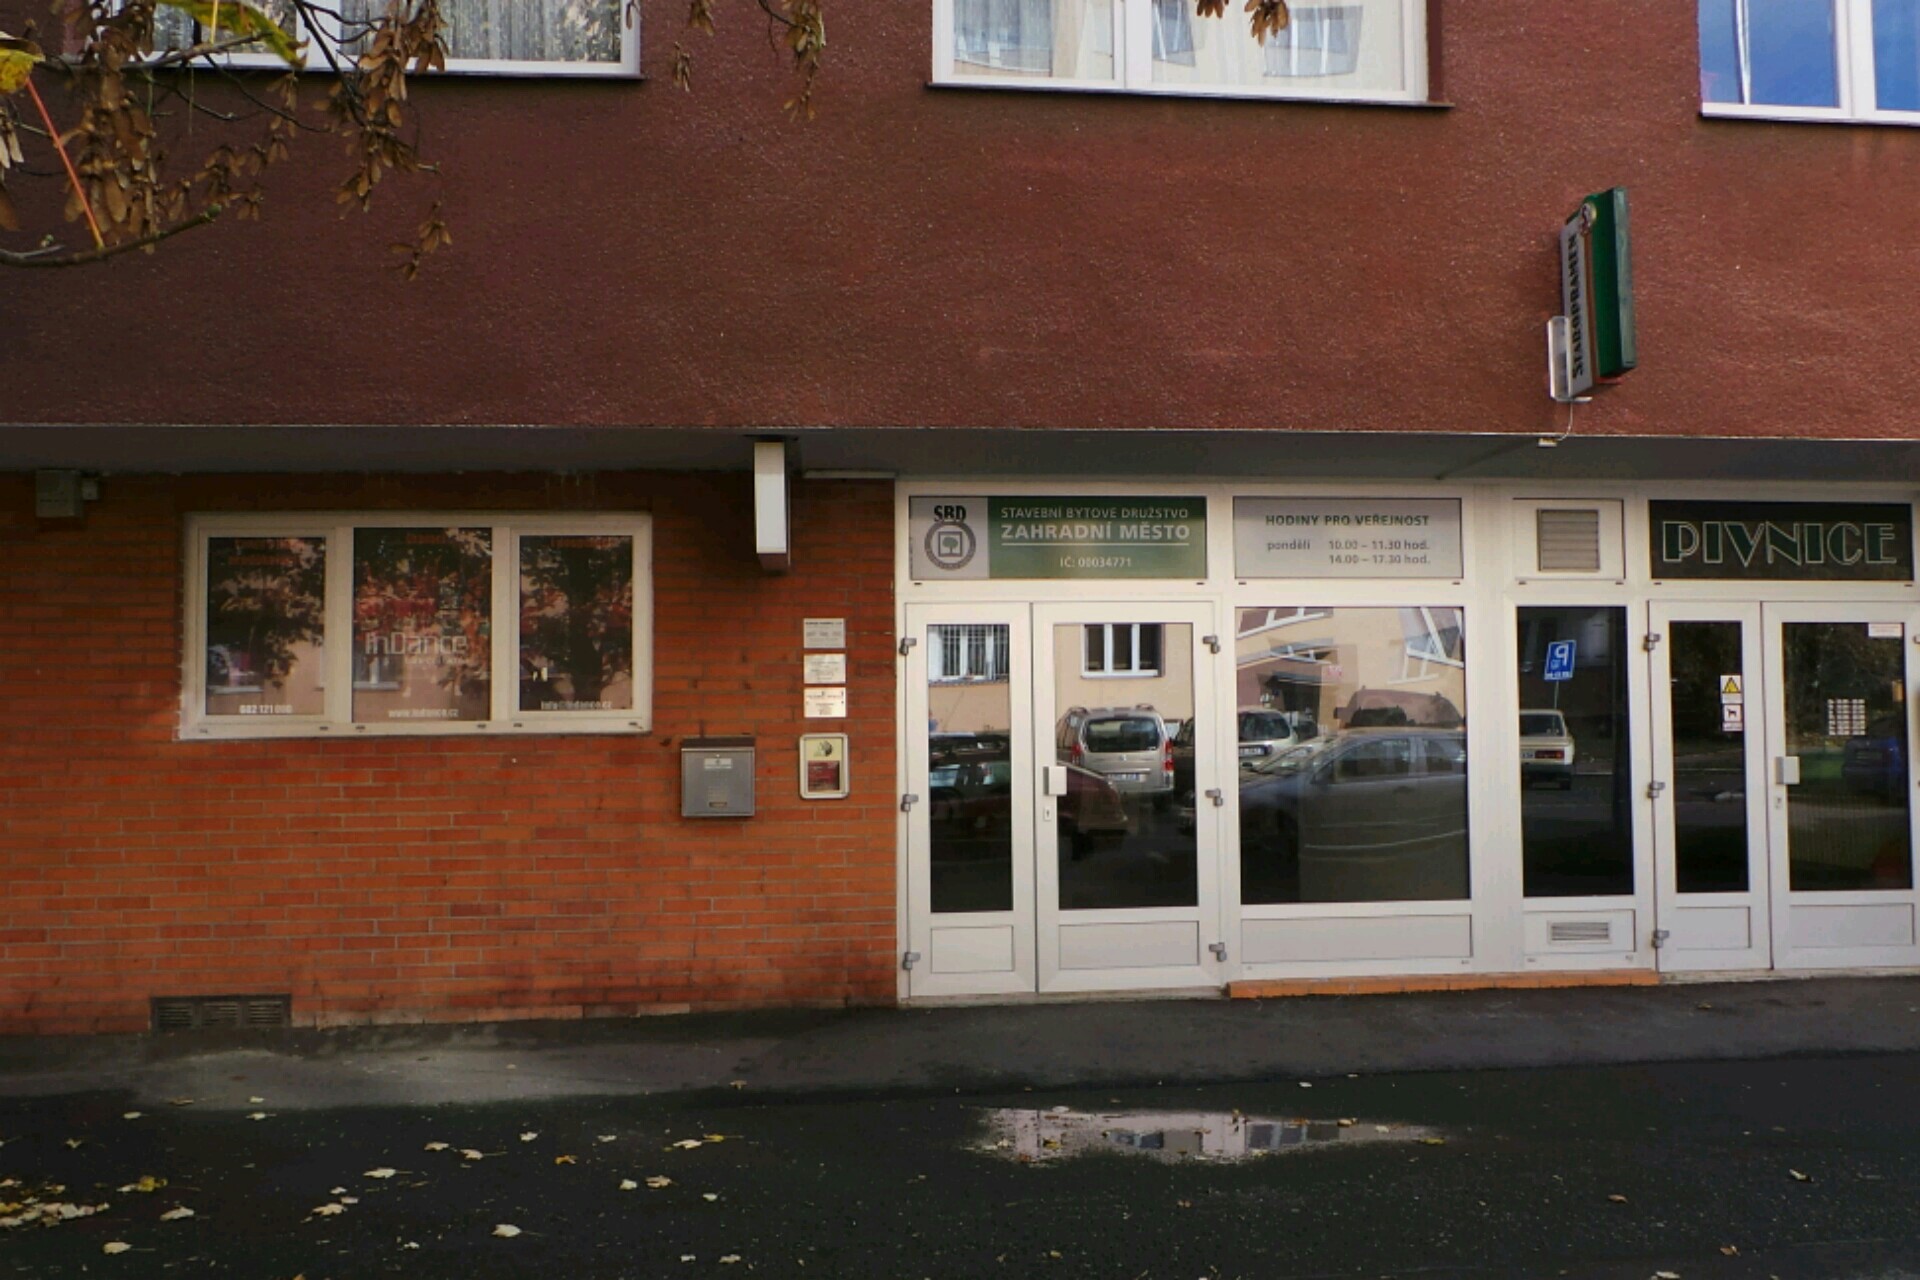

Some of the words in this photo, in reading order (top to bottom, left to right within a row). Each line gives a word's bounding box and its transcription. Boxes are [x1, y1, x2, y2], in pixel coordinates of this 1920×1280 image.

[1568, 236, 1584, 379] STAROPRAMEN
[933, 505, 967, 522] SBD
[1266, 515, 1319, 526] HODINY
[1325, 515, 1350, 526] PRO
[1355, 513, 1429, 526] VEŘEJNOST
[1001, 521, 1112, 539] ZAHRADNÍ
[1120, 521, 1190, 539] MĚSTO
[1662, 520, 1897, 568] PIVNICE
